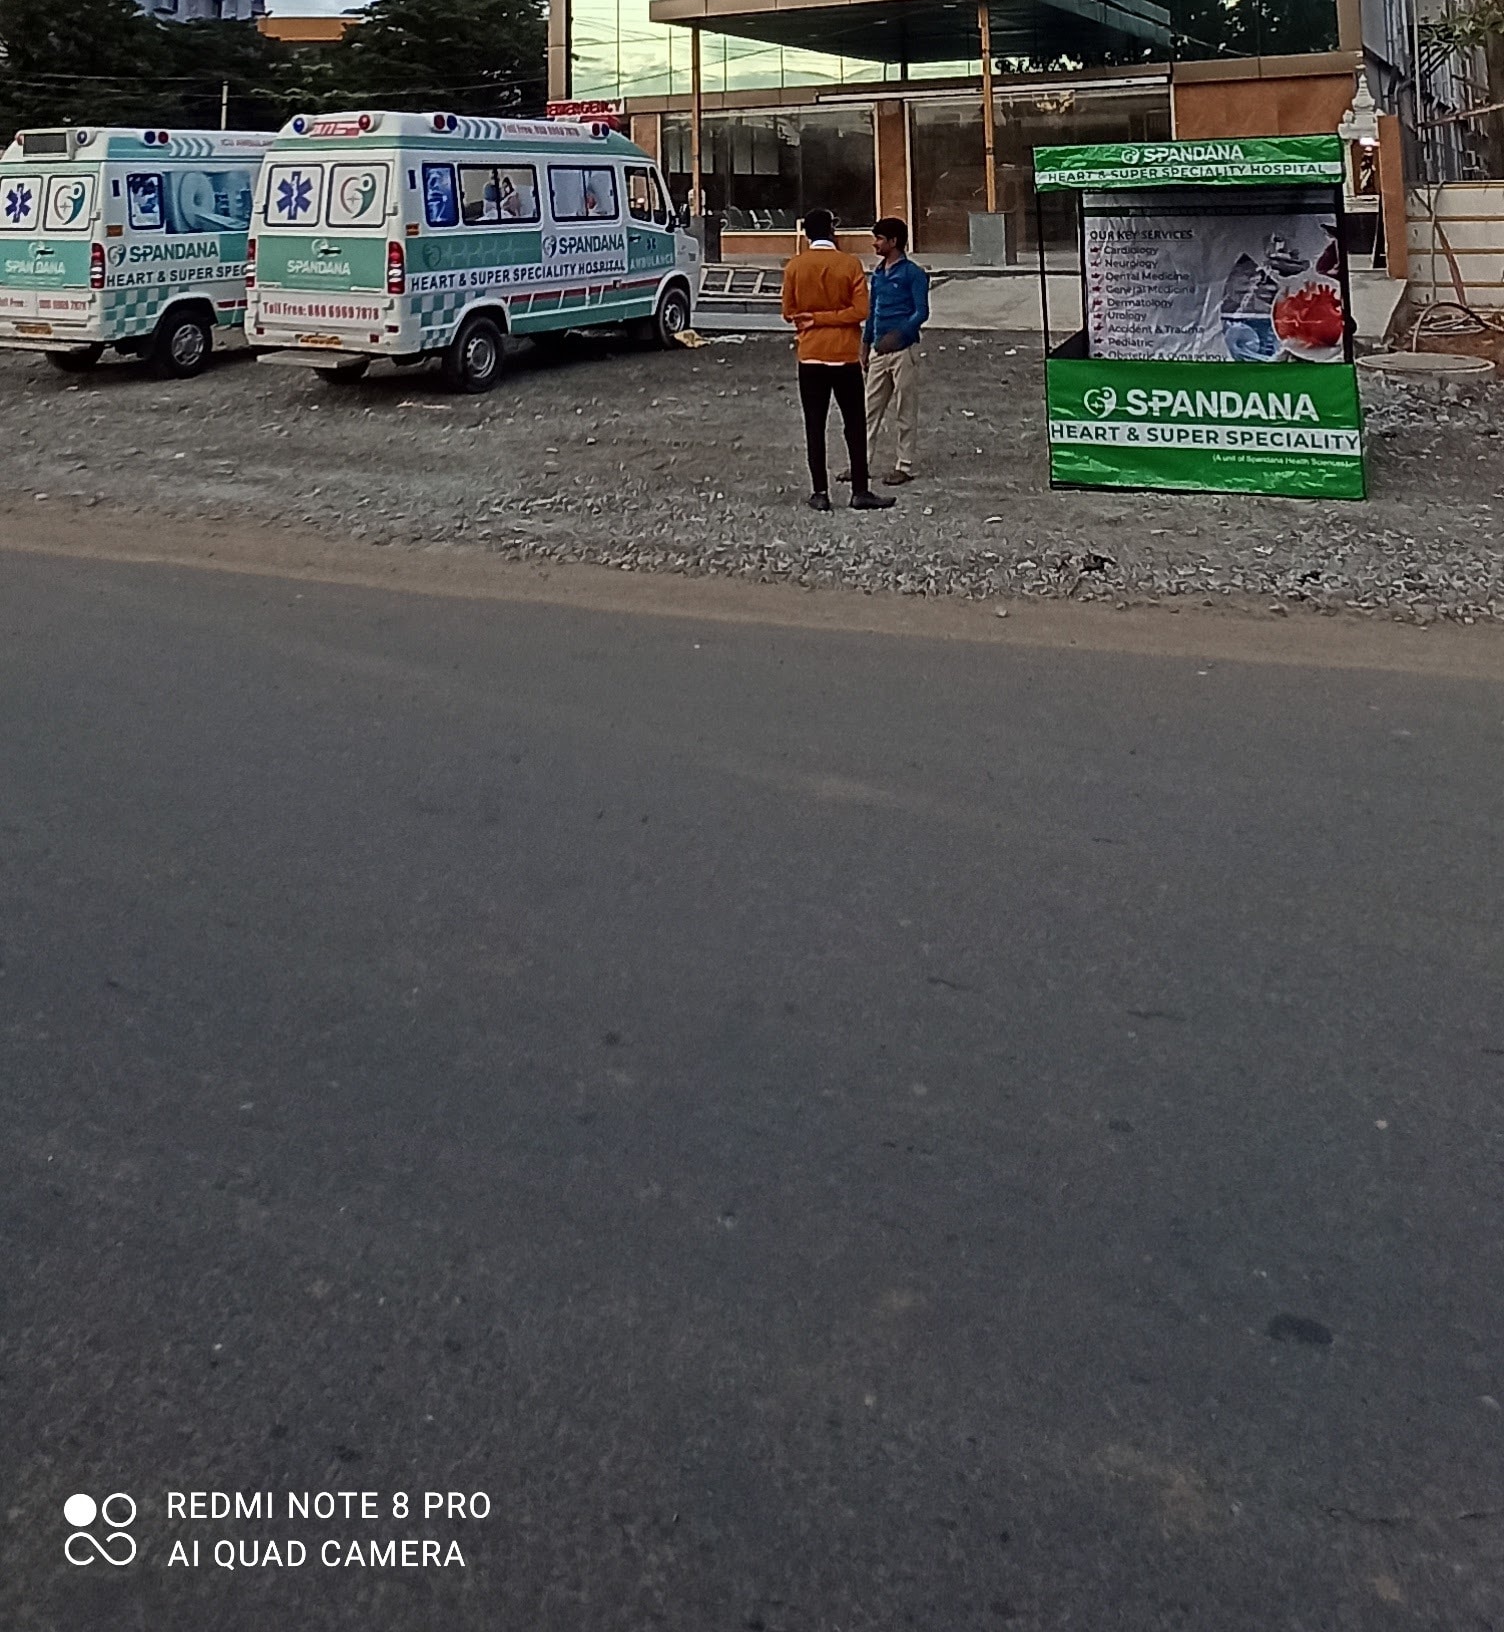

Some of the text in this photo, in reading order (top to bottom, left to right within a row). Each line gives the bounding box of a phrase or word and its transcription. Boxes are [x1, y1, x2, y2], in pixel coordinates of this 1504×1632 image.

[1049, 170, 1093, 184] HEART
[1110, 168, 1158, 180] SUPER
[1162, 165, 1246, 178] SPECIALITY
[1251, 162, 1326, 175] HOSPITAL
[1090, 229, 1194, 240] OUR KEY SERVICES
[1104, 246, 1159, 256] Cardiology
[1105, 259, 1159, 269] Neurology
[106, 271, 153, 287] HEART
[157, 270, 166, 283] &
[170, 267, 213, 281] SUPER
[411, 259, 626, 293] HEART & SUPER SPECIALITY HOSPITAL
[1105, 272, 1190, 281] Dental Medicine
[263, 302, 281, 314] Toll
[1107, 298, 1174, 308] Dermatology
[1107, 311, 1147, 321] Urology
[1108, 324, 1206, 334] Accident & Trauma
[1108, 338, 1154, 348] Pediatric
[1050, 423, 1359, 451] HEART & SUPER SPECIALITY
